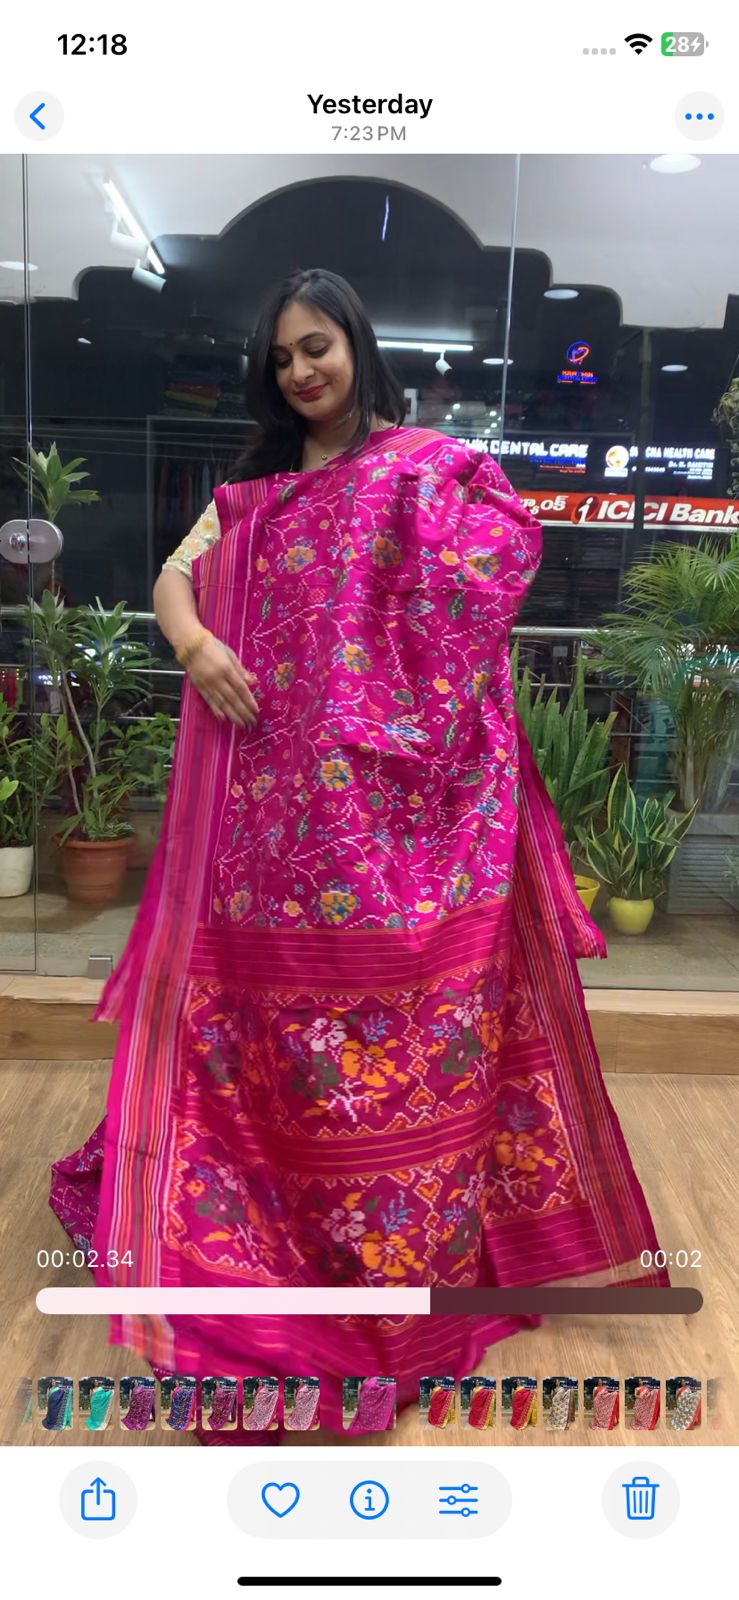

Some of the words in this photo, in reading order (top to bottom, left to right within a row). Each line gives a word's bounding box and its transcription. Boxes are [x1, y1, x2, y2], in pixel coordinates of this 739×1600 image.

[490, 440, 548, 456] DENTAL
[550, 444, 589, 458] CARE
[663, 447, 693, 459] HEALTH
[694, 448, 716, 460] CARE
[597, 500, 669, 522] ICICI
[669, 502, 739, 524] Bank
